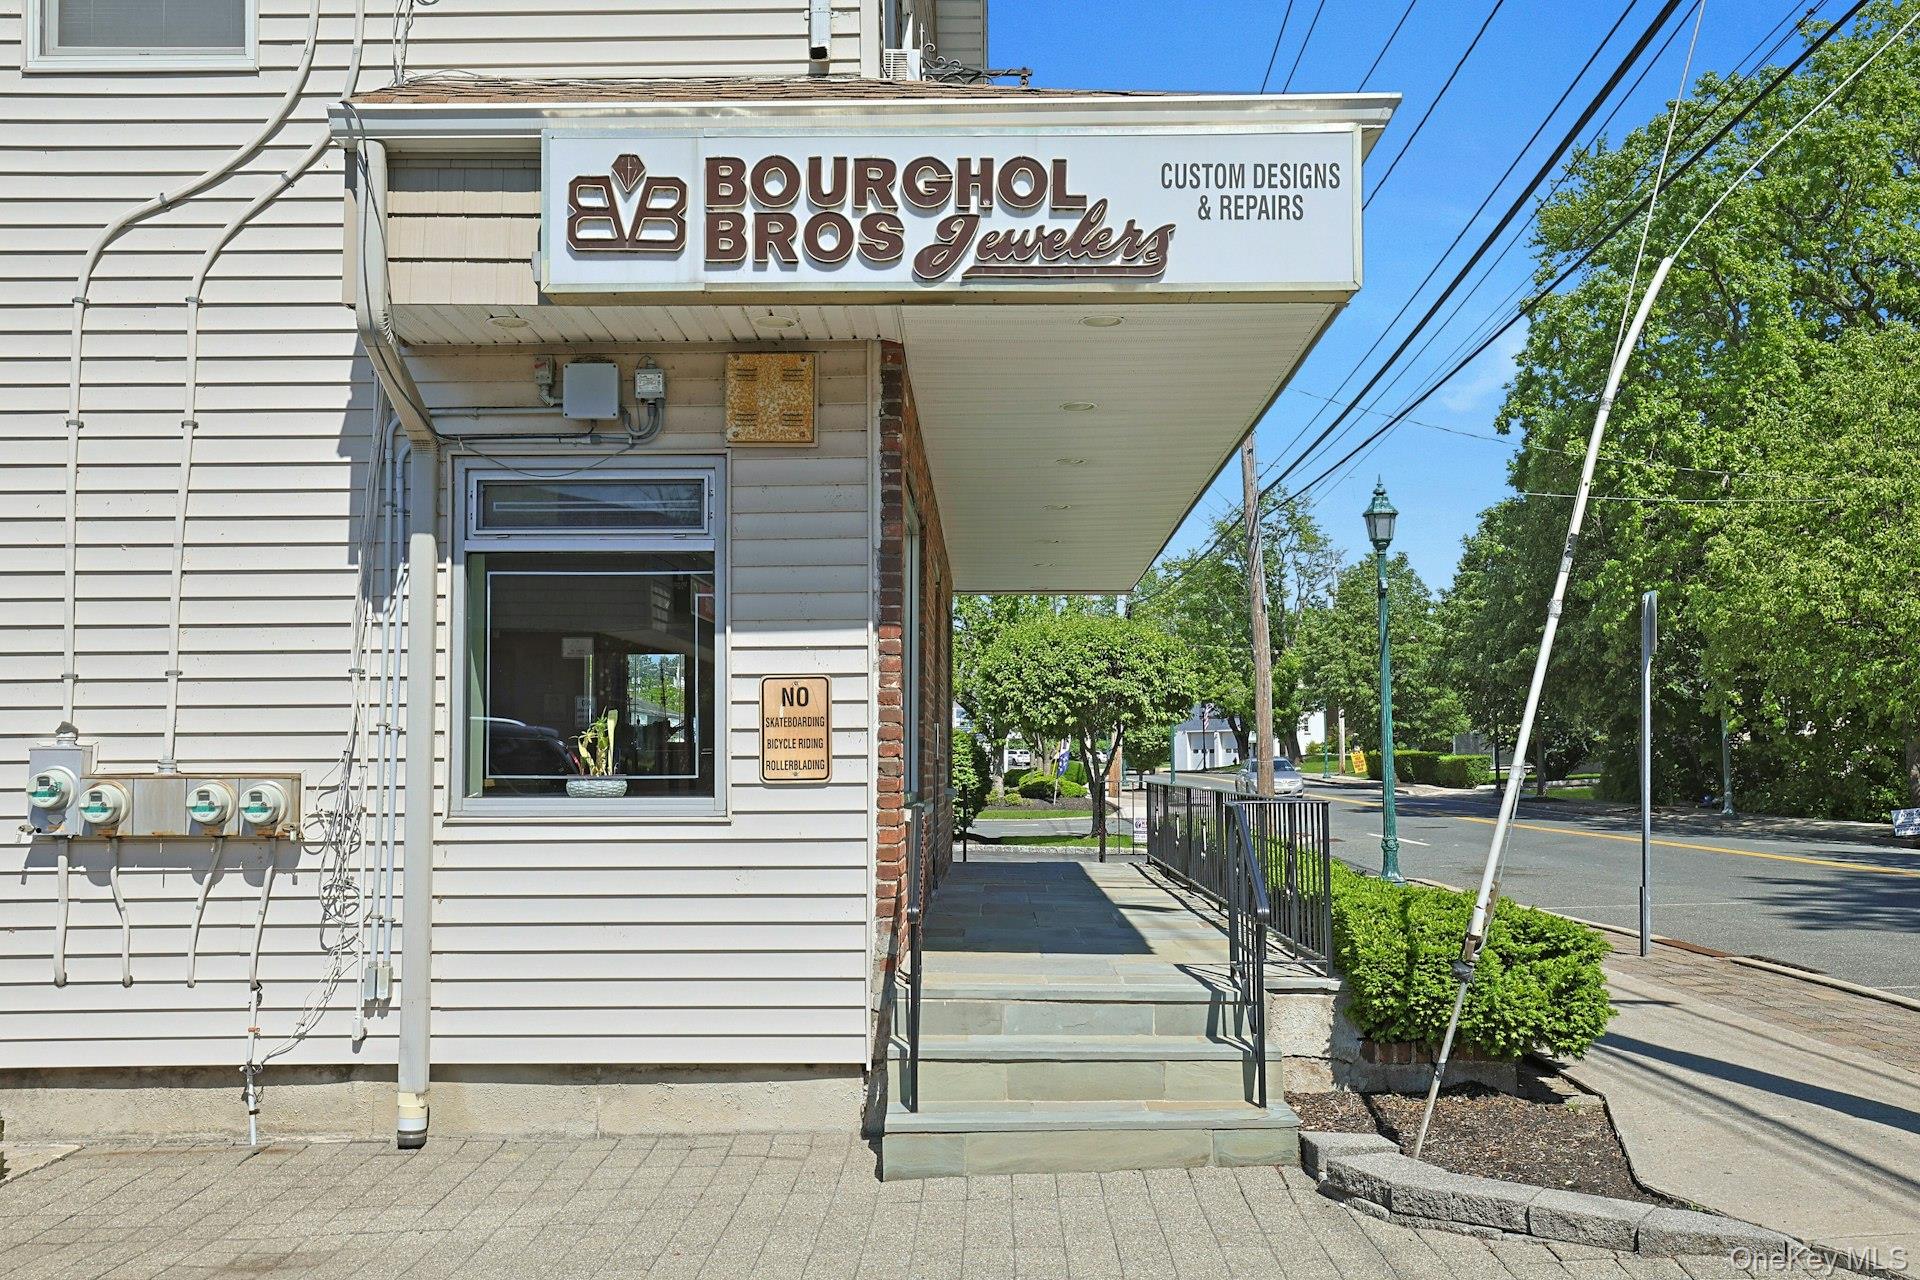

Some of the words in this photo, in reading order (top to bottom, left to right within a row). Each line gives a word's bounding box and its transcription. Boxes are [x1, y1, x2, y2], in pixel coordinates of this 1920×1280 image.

[705, 155, 1087, 209] BOURGHOL
[1160, 162, 1246, 190] CUSTOM
[1253, 162, 1341, 190] DESIGNS
[1197, 194, 1212, 221] &
[1219, 194, 1304, 221] REPAIRS
[705, 211, 904, 263] BROS
[912, 198, 1176, 280] Jewelers
[781, 686, 809, 707] NO
[765, 716, 825, 728] SKATEBOARDING
[767, 738, 796, 750] BICYCLE
[798, 737, 824, 749] RIDING
[765, 759, 825, 771] ROLLERBLADING
